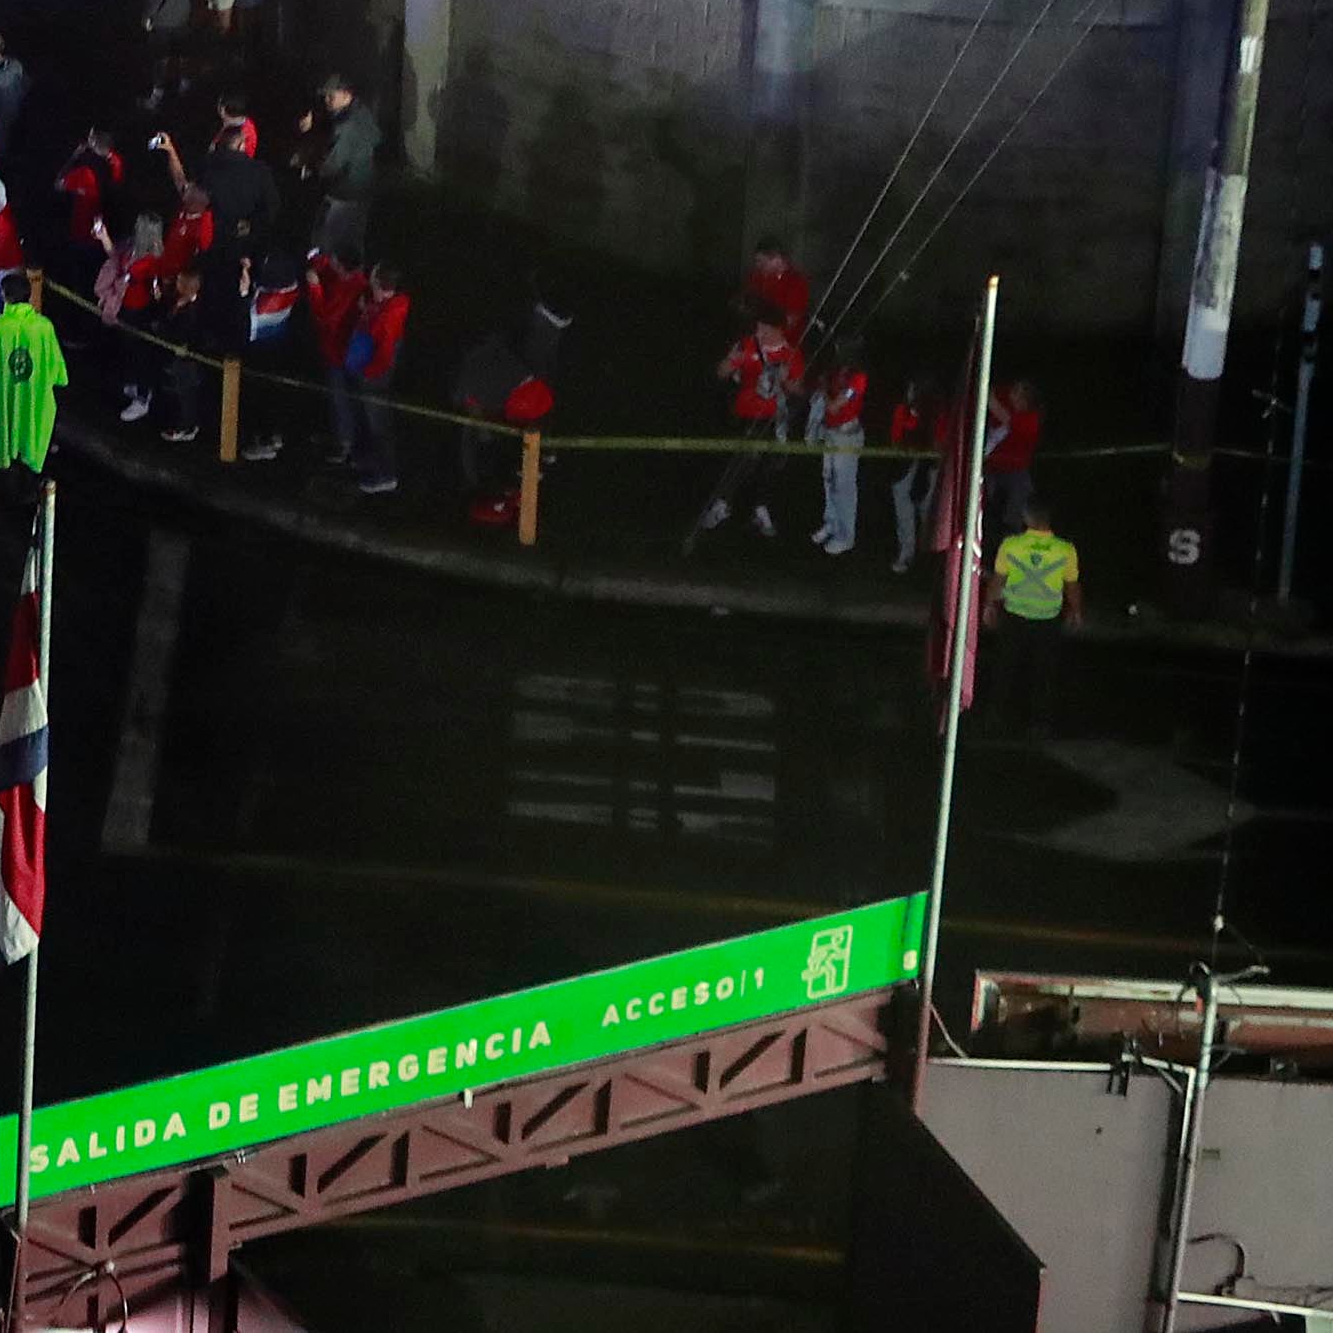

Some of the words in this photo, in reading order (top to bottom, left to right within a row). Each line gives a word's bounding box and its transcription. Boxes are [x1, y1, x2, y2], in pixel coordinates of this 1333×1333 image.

[1167, 529, 1201, 564] S
[27, 1112, 186, 1175] SALIDA
[208, 1093, 261, 1131] DE
[277, 1021, 551, 1112] EMERGENCIA
